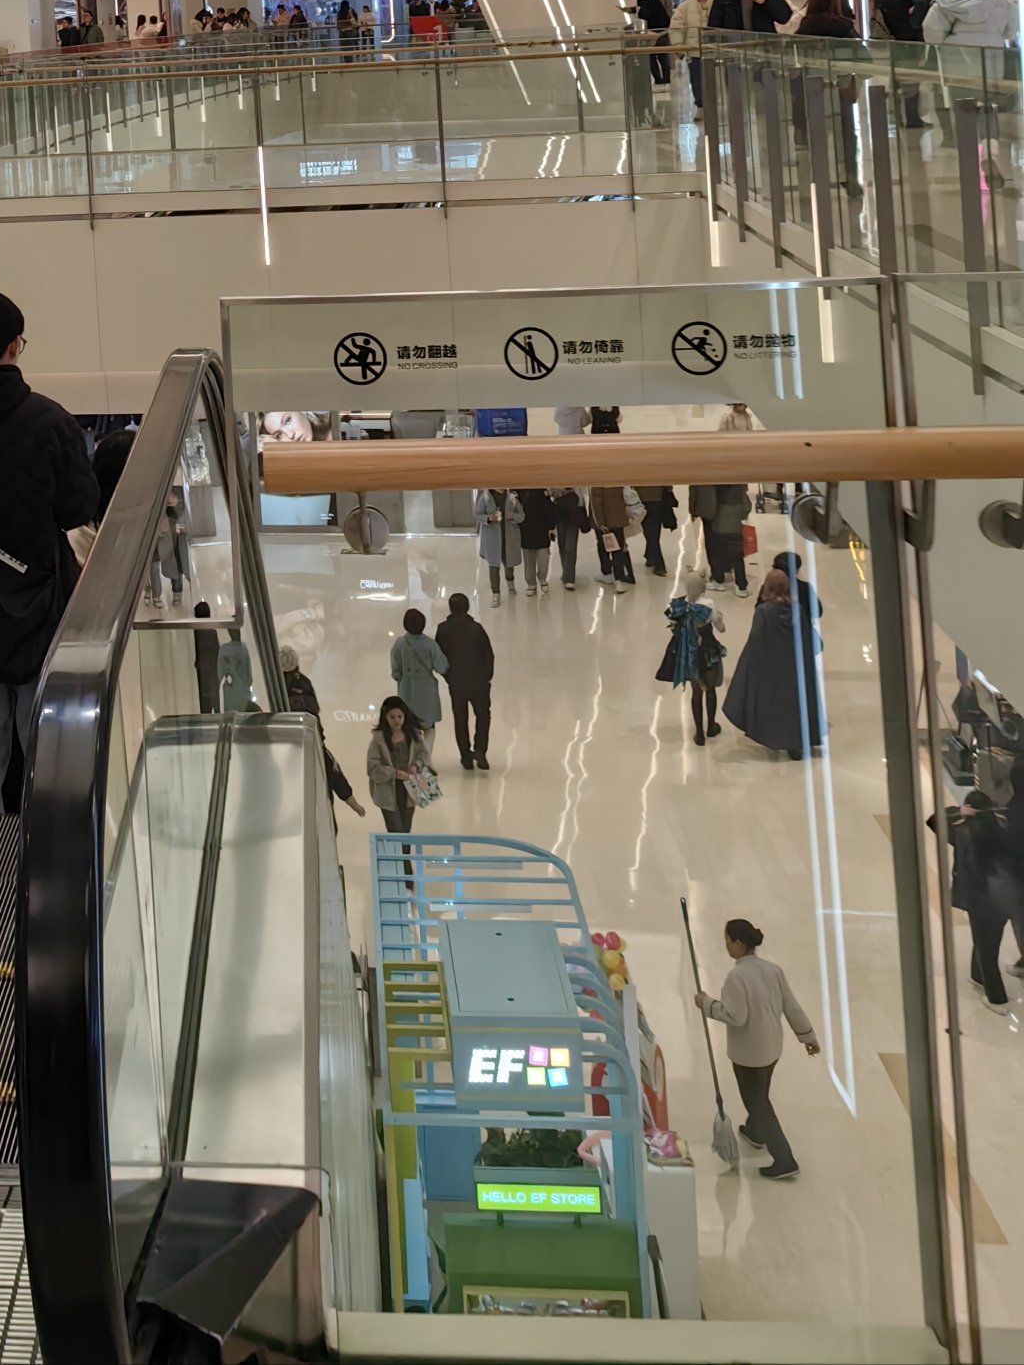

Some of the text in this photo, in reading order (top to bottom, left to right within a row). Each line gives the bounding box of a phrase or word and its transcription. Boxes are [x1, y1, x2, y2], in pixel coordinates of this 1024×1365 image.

[397, 344, 458, 360] 请勿翻越
[562, 339, 624, 355] 请勿倚靠
[398, 361, 458, 370] NO CROSSING
[468, 1047, 525, 1084] EF
[530, 1192, 548, 1205] EF
[551, 1193, 596, 1207] STORE
